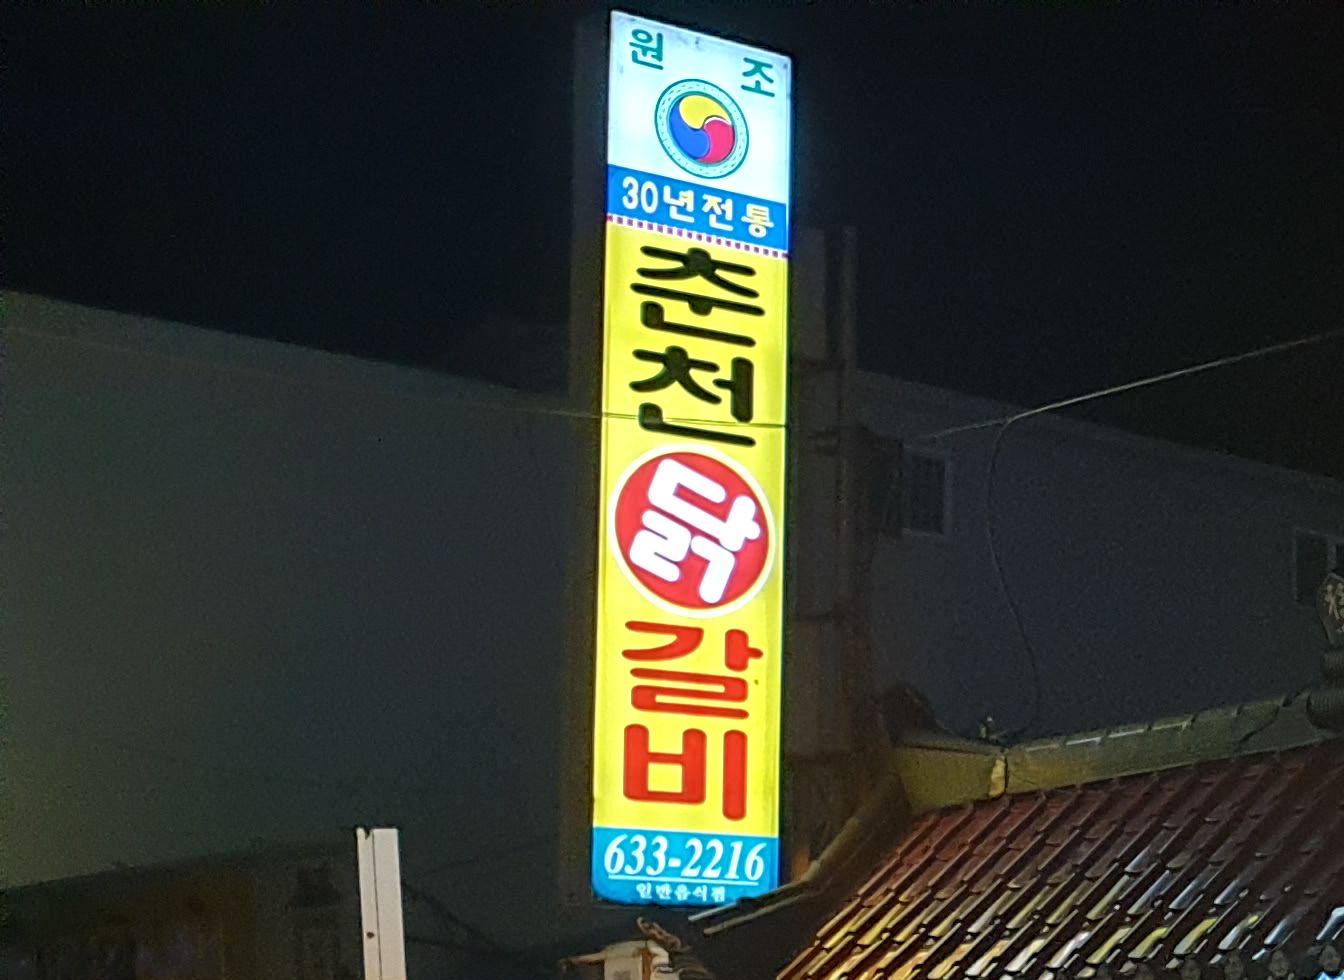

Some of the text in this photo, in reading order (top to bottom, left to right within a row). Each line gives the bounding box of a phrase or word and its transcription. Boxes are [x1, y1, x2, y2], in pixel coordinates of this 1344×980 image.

[621, 176, 775, 239] 30년전통
[629, 246, 766, 448] 춘천
[603, 834, 767, 882] 633-2216
